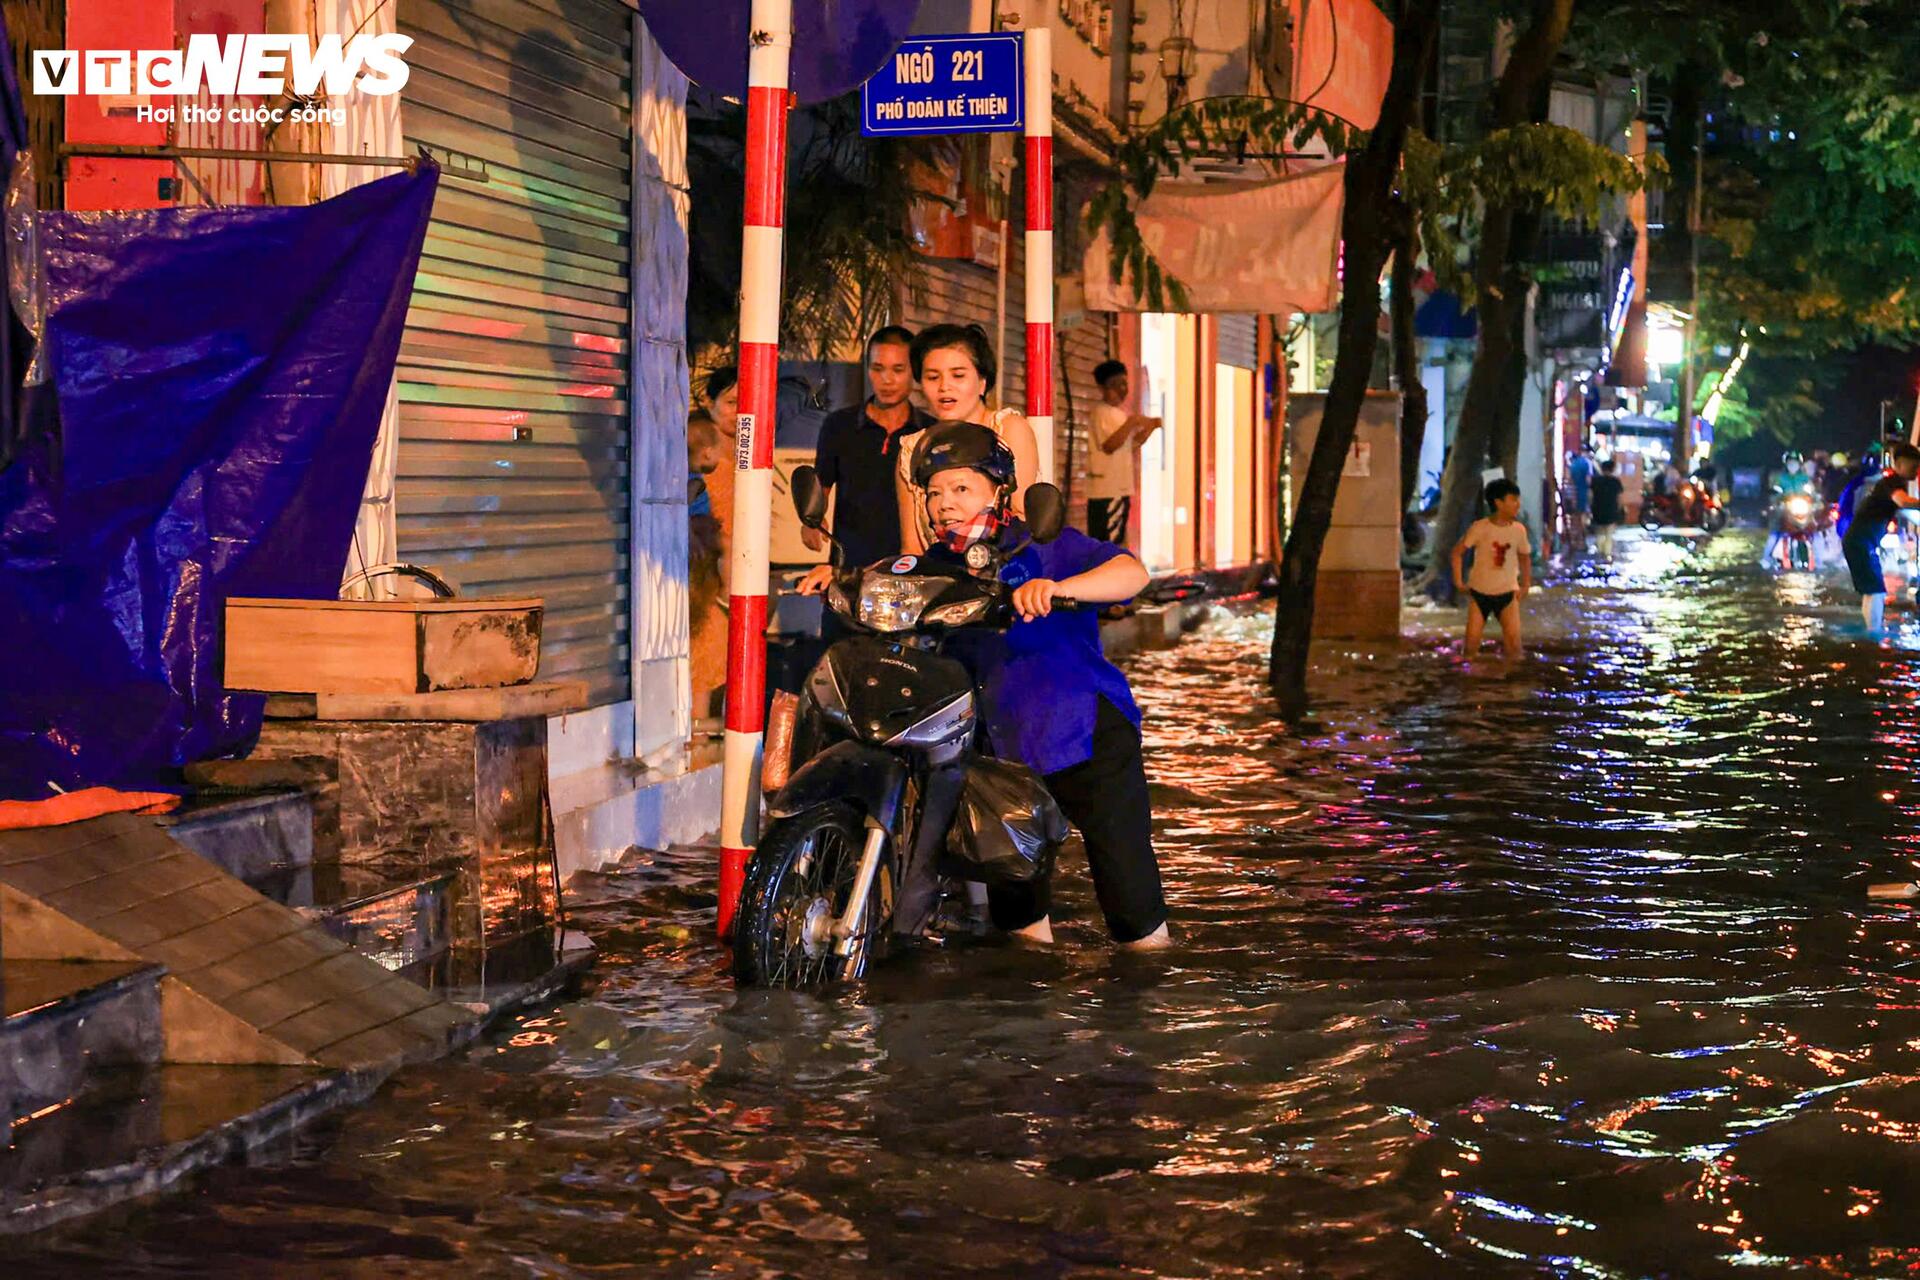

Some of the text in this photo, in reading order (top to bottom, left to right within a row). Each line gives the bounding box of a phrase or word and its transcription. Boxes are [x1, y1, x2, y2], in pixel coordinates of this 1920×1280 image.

[895, 46, 983, 84] NGÕ 221
[876, 93, 1008, 120] PHỐ DOÃN KẾ THIỆN
[738, 416, 752, 470] 0973.002.395
[880, 657, 918, 673] HONDA
